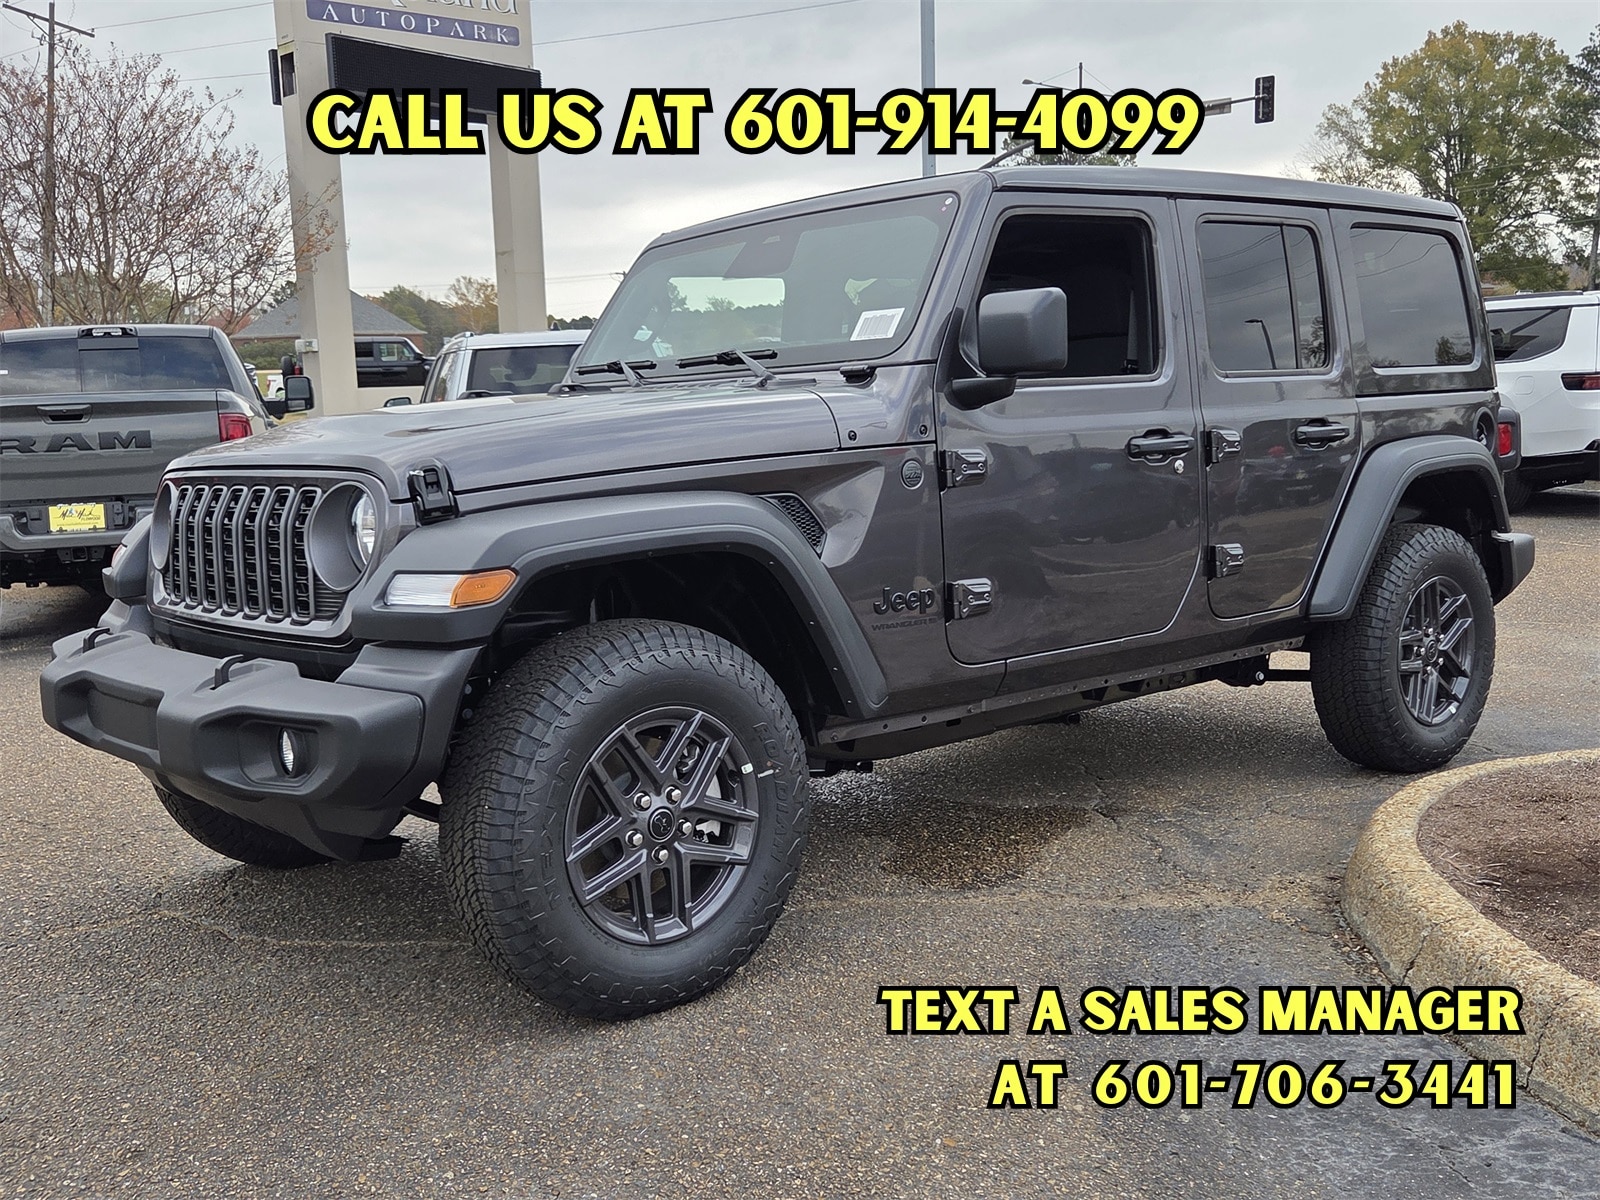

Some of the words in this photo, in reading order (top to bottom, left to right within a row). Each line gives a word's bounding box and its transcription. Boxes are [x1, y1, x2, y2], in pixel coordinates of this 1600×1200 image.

[321, 3, 509, 43] AUTOPARK
[0, 430, 152, 453] RAM
[873, 587, 936, 615] Jeep
[871, 618, 928, 631] WRANGLER
